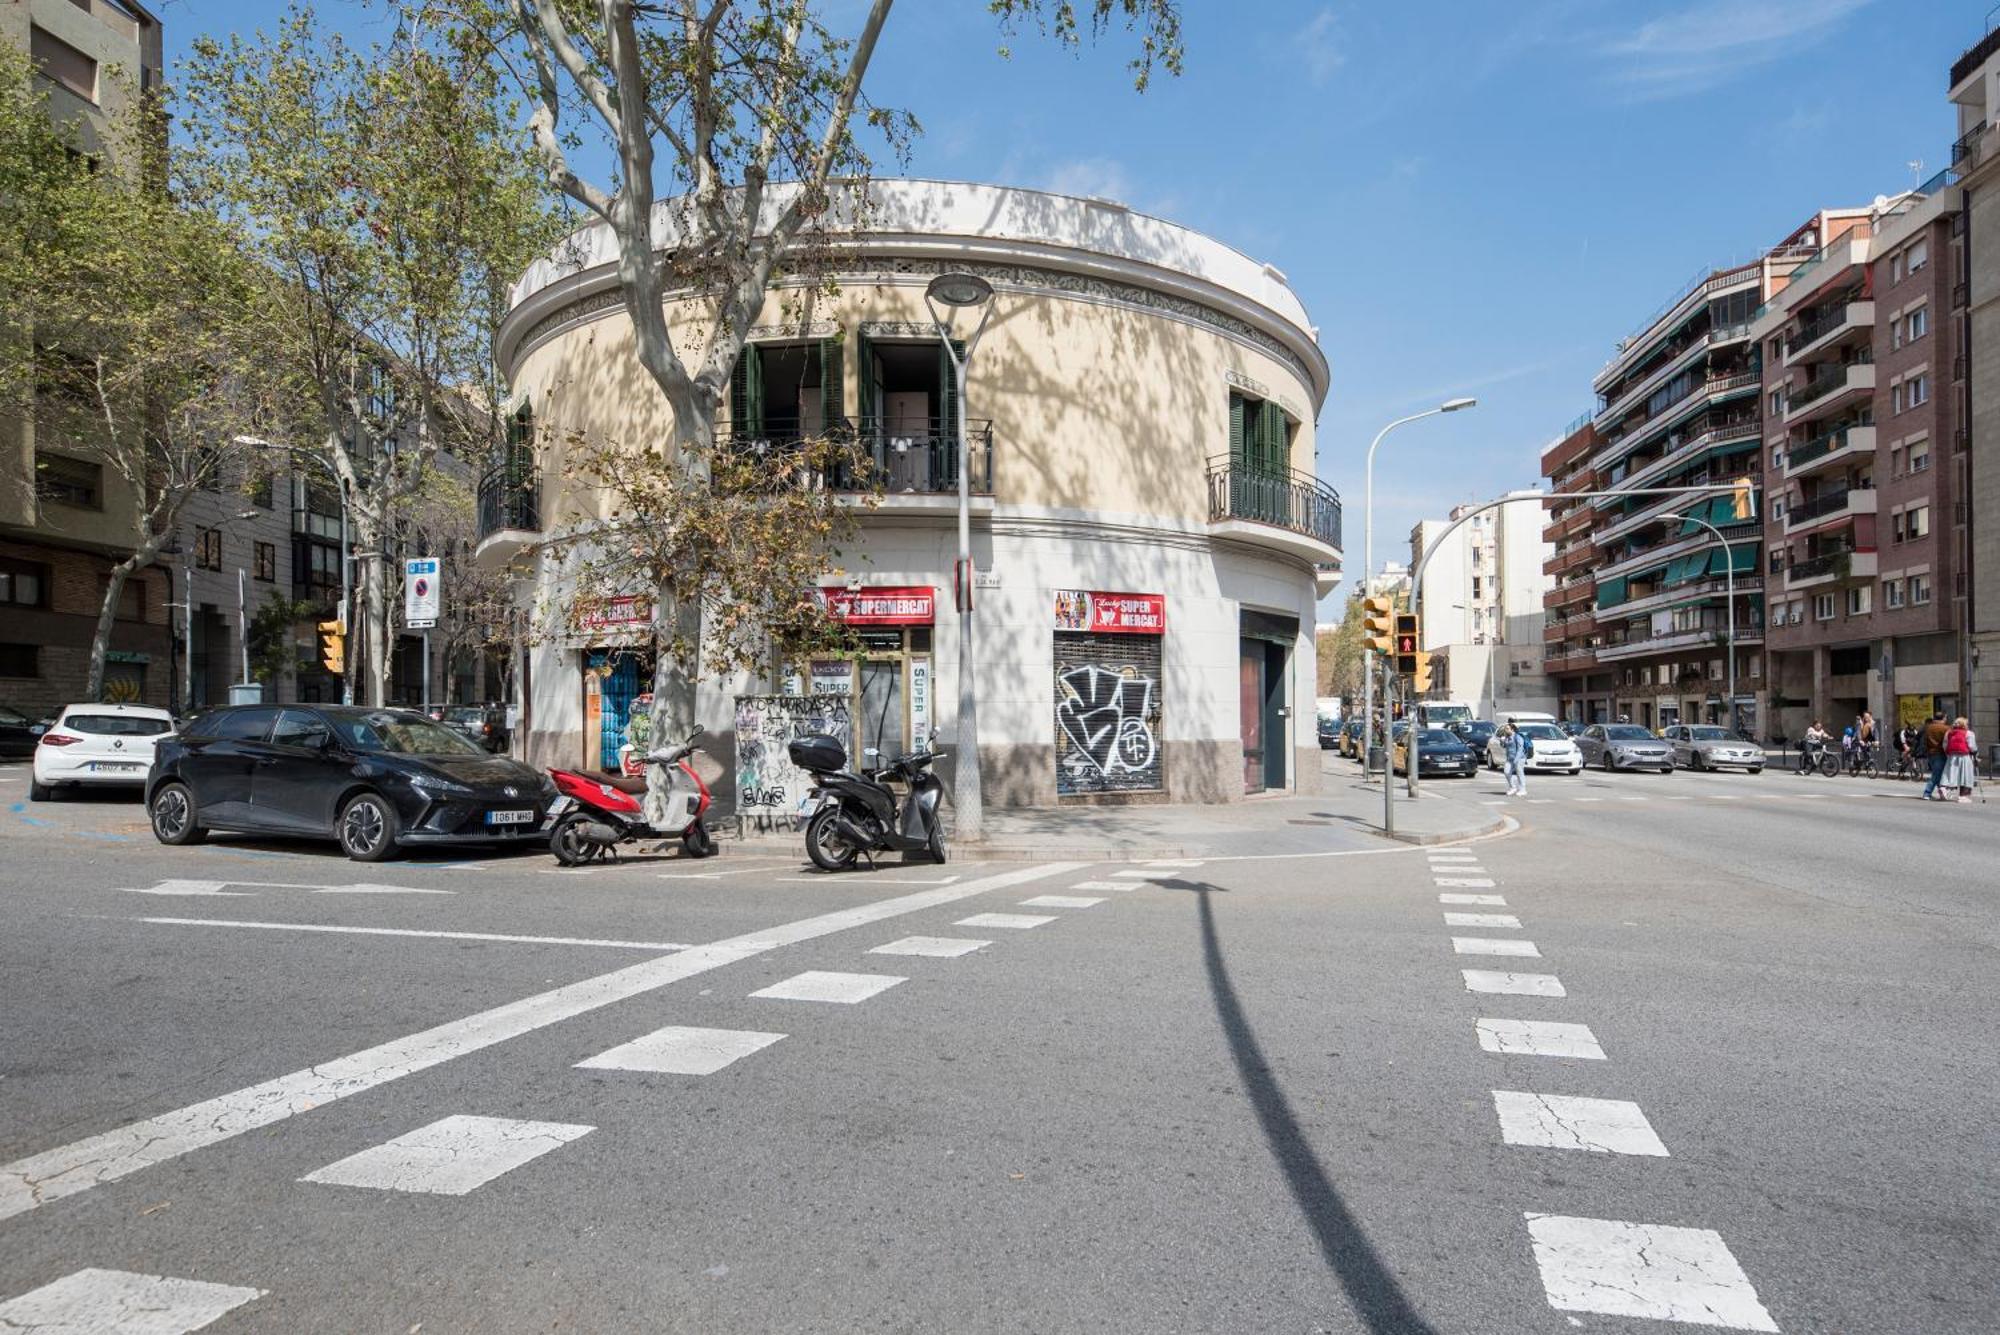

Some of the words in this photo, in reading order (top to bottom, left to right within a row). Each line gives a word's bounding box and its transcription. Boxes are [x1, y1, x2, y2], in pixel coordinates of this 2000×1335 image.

[853, 599, 929, 615] SUPERMERCAT
[1121, 599, 1150, 613] SUPER
[1121, 614, 1158, 628] MERCAT
[815, 681, 849, 694] SUPER
[914, 668, 925, 713] SUPER
[495, 813, 515, 822] 1061
